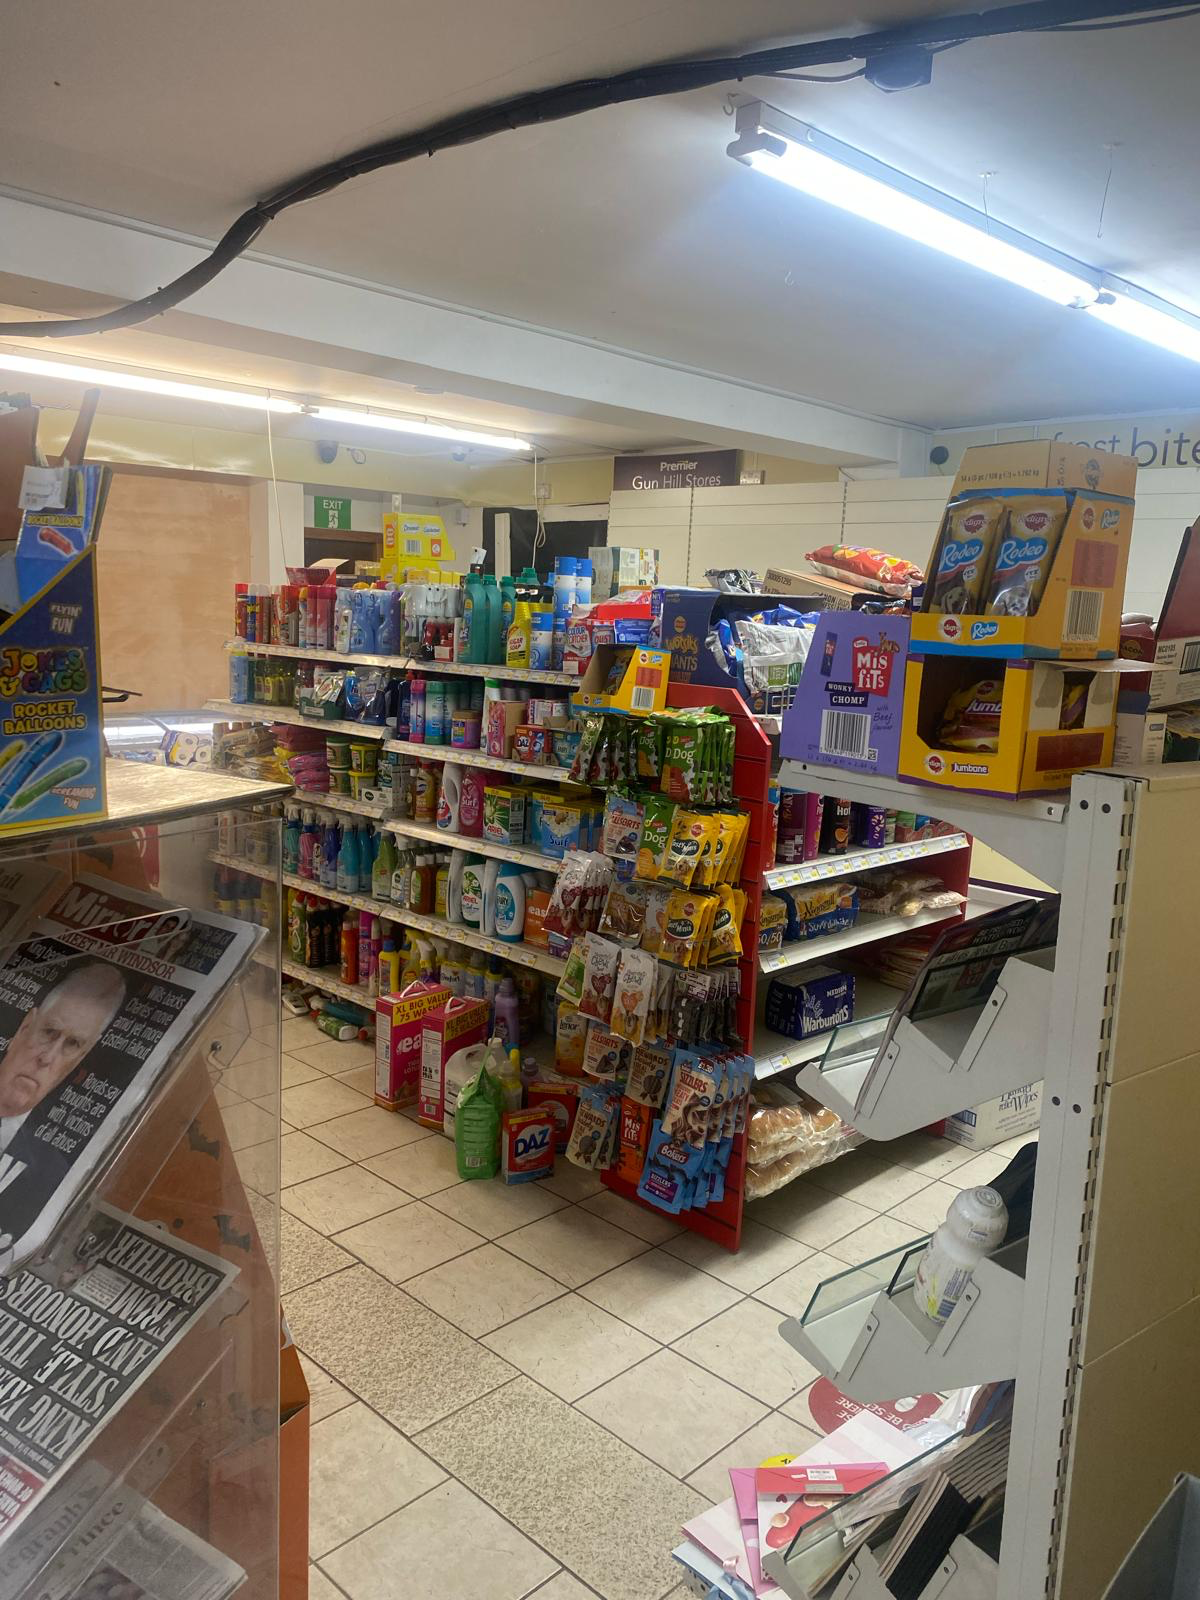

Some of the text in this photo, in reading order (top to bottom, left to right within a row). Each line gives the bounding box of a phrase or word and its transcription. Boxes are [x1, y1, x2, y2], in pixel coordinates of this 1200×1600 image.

[660, 461, 698, 471] Premier
[632, 474, 721, 489] Gun Hill Stores
[323, 500, 343, 509] EXIT
[942, 543, 981, 567] Rodeo
[1000, 543, 1046, 567] Rodeo
[51, 618, 73, 633] FUN
[972, 623, 999, 639] Rodeo
[509, 637, 523, 646] SUGAR
[509, 644, 521, 652] SOAP
[3, 648, 82, 675] JOKES
[857, 653, 887, 673] Mis
[21, 671, 87, 693] GAGS
[828, 683, 853, 692] WONKY
[14, 700, 74, 717] ROCKET
[832, 695, 865, 705] CHOMP
[4, 715, 86, 735] BALLOONS
[873, 712, 893, 725] Beef
[673, 748, 695, 764] Dog
[952, 763, 989, 775] Jumbone
[64, 798, 80, 810] FUN
[487, 825, 504, 836] ARIEL
[549, 836, 568, 847] Surf
[644, 832, 667, 848] Dog
[463, 895, 478, 905] ARIEL
[54, 887, 151, 943] Mirror
[57, 931, 177, 981] MEET MR WINDSOR
[826, 985, 847, 997] MEDIUM
[396, 991, 452, 1015] XL BIG VALUE
[399, 1012, 410, 1022] 75
[802, 1004, 849, 1034] Warburtons
[145, 1027, 162, 1043] more
[680, 1071, 709, 1093] SIZZLERS
[60, 1086, 106, 1117] thoughts are
[106, 1086, 122, 1103] say
[513, 1127, 550, 1158] DAZ
[661, 1145, 687, 1163] Bakers
[106, 1228, 224, 1308] BROTHER
[110, 1281, 191, 1342] FROM
[91, 1323, 159, 1377] AND
[884, 1405, 903, 1425] BE
[16, 1394, 92, 1461] KING
